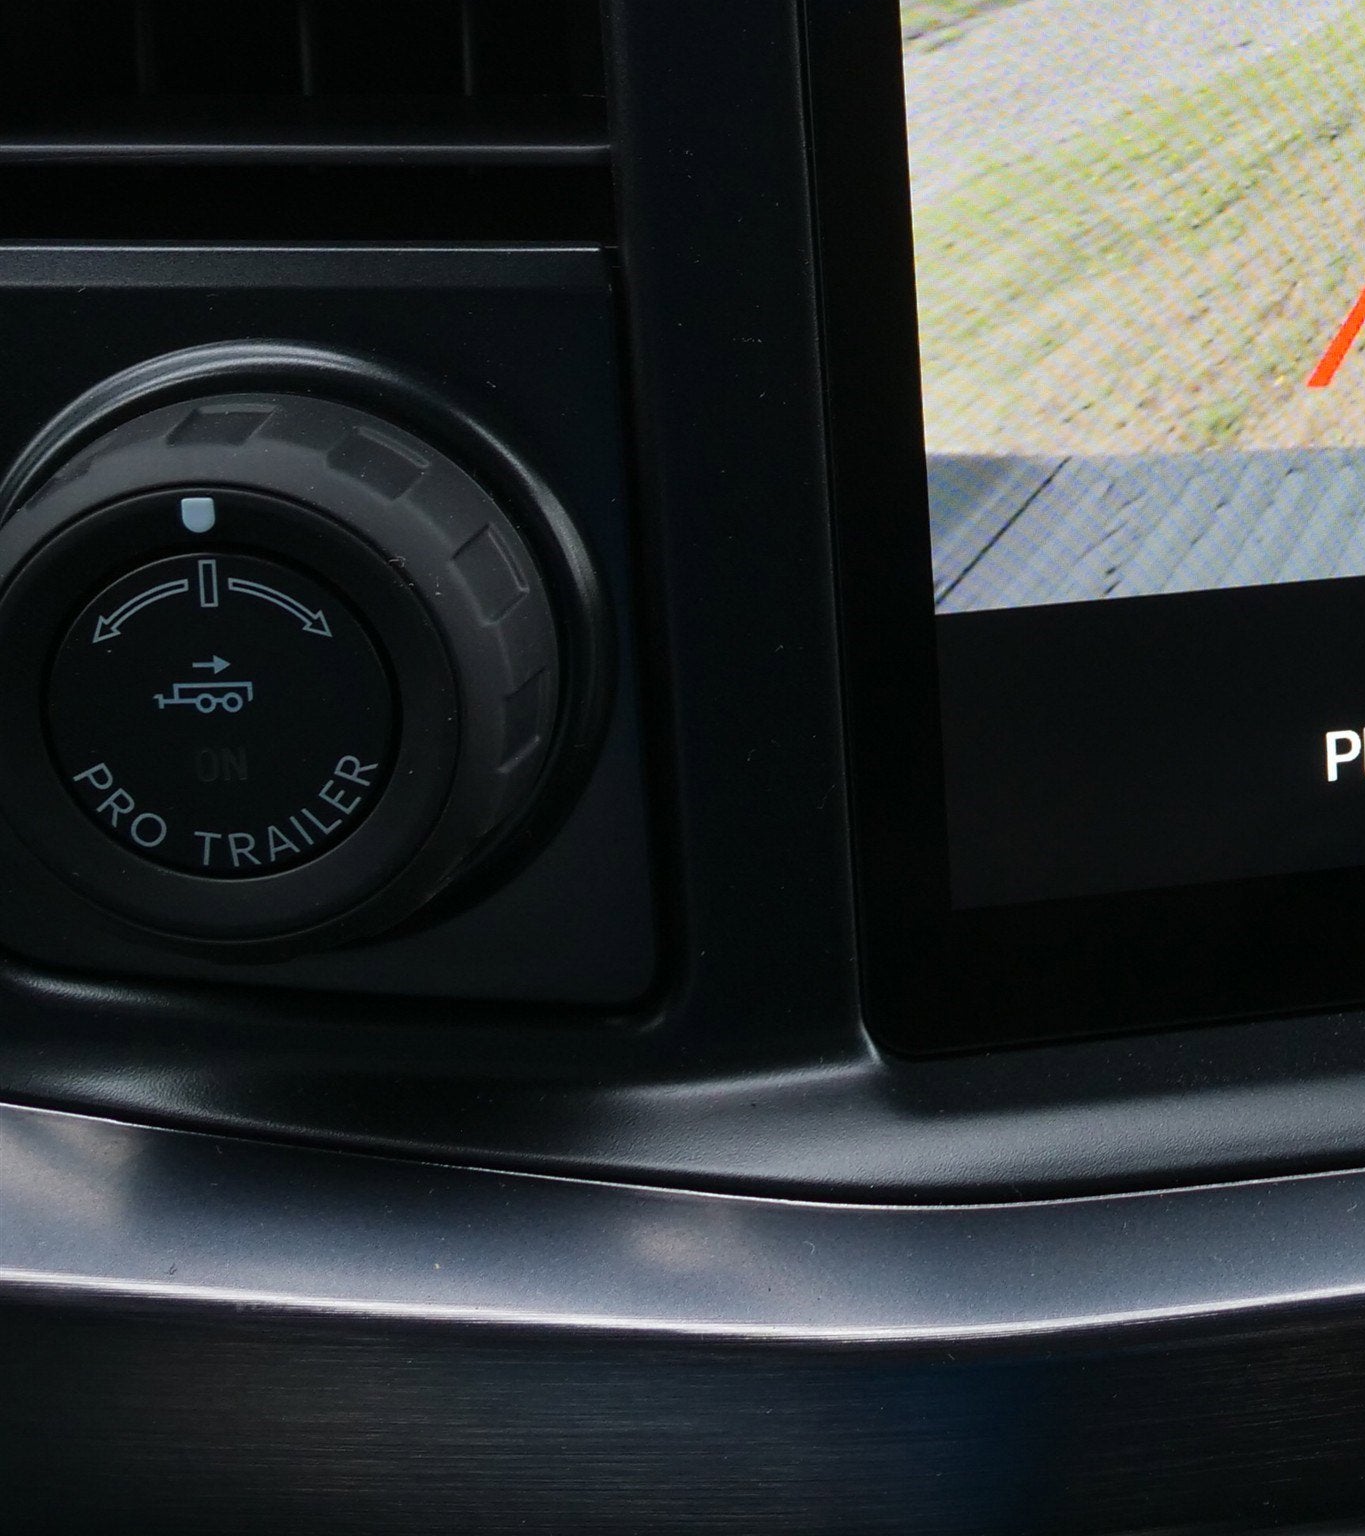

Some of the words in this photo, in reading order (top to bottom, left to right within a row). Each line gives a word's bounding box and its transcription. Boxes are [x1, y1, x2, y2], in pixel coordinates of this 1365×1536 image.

[197, 746, 248, 783] ON
[72, 762, 168, 848] PRO
[193, 754, 379, 867] TRAILER
